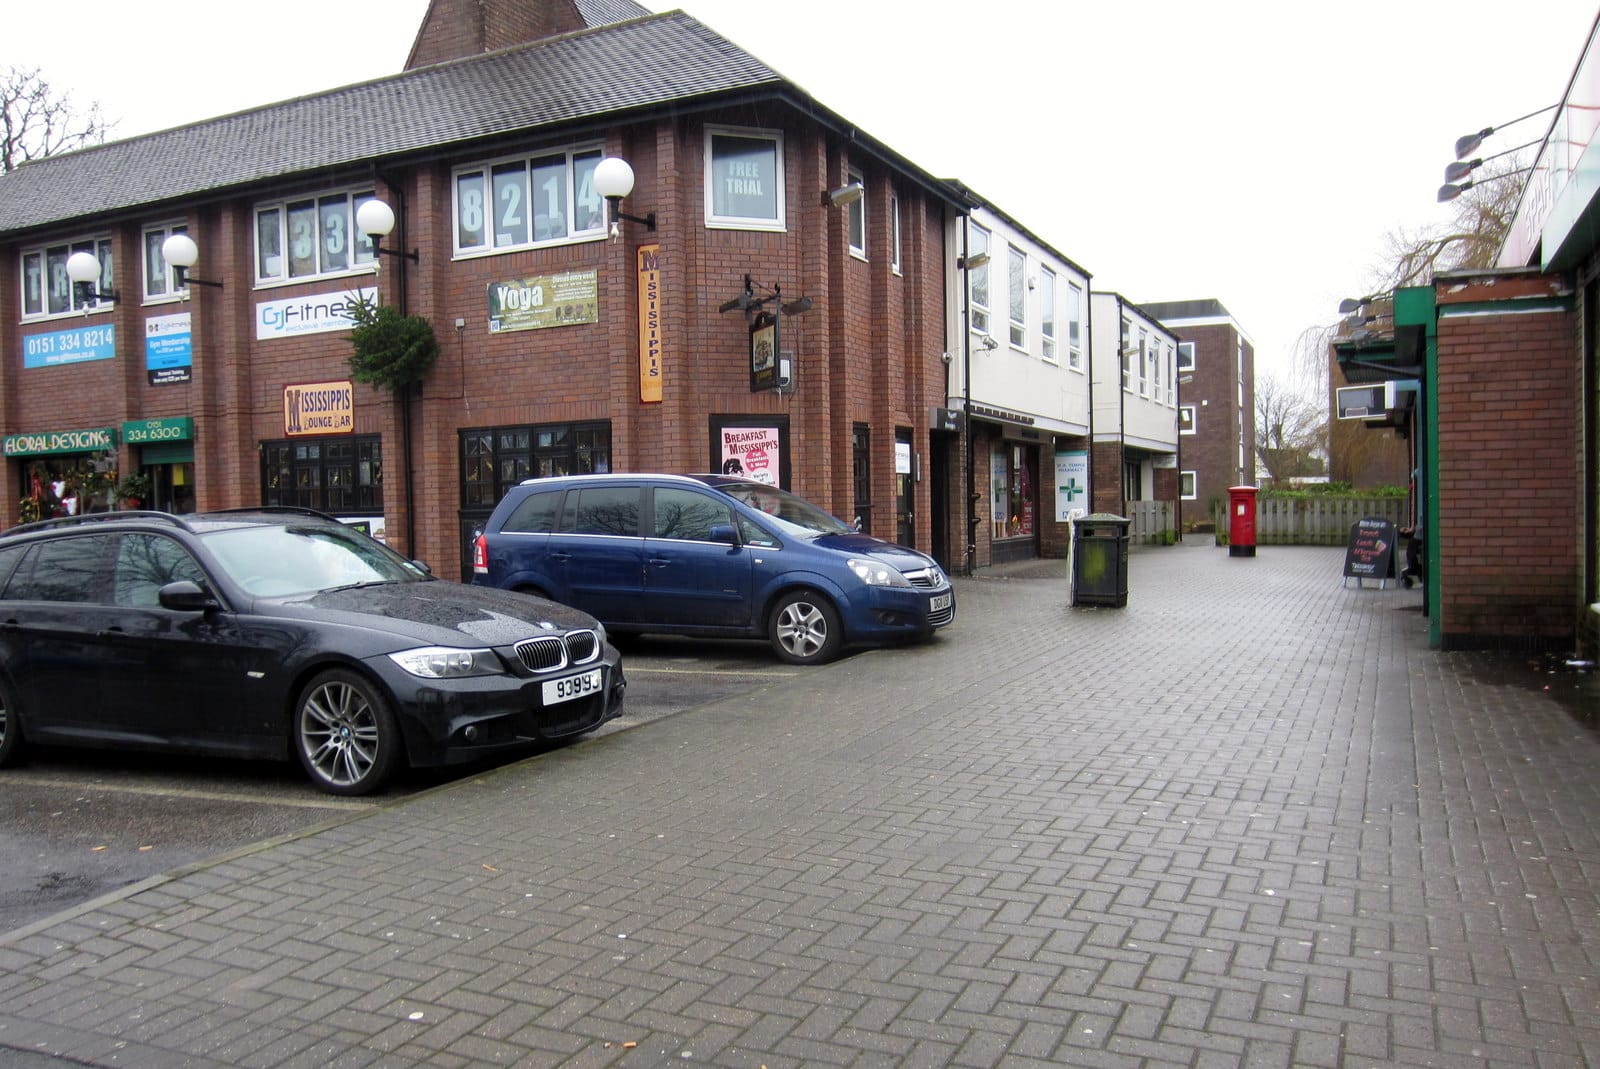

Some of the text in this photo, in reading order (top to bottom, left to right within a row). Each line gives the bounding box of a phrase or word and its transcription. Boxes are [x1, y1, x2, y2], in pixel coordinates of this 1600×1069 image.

[729, 160, 759, 177] FREE
[726, 178, 763, 196] TRIAL
[497, 286, 544, 311] Yoga
[29, 328, 113, 355] 0151 334 8214
[304, 414, 350, 430] LOUNGE BAR
[128, 427, 180, 440] 334 6300
[724, 430, 767, 444] BREAKFAST
[5, 430, 104, 455] FLORAL DESIGNS
[729, 440, 778, 455] MISSISSIPPI'S
